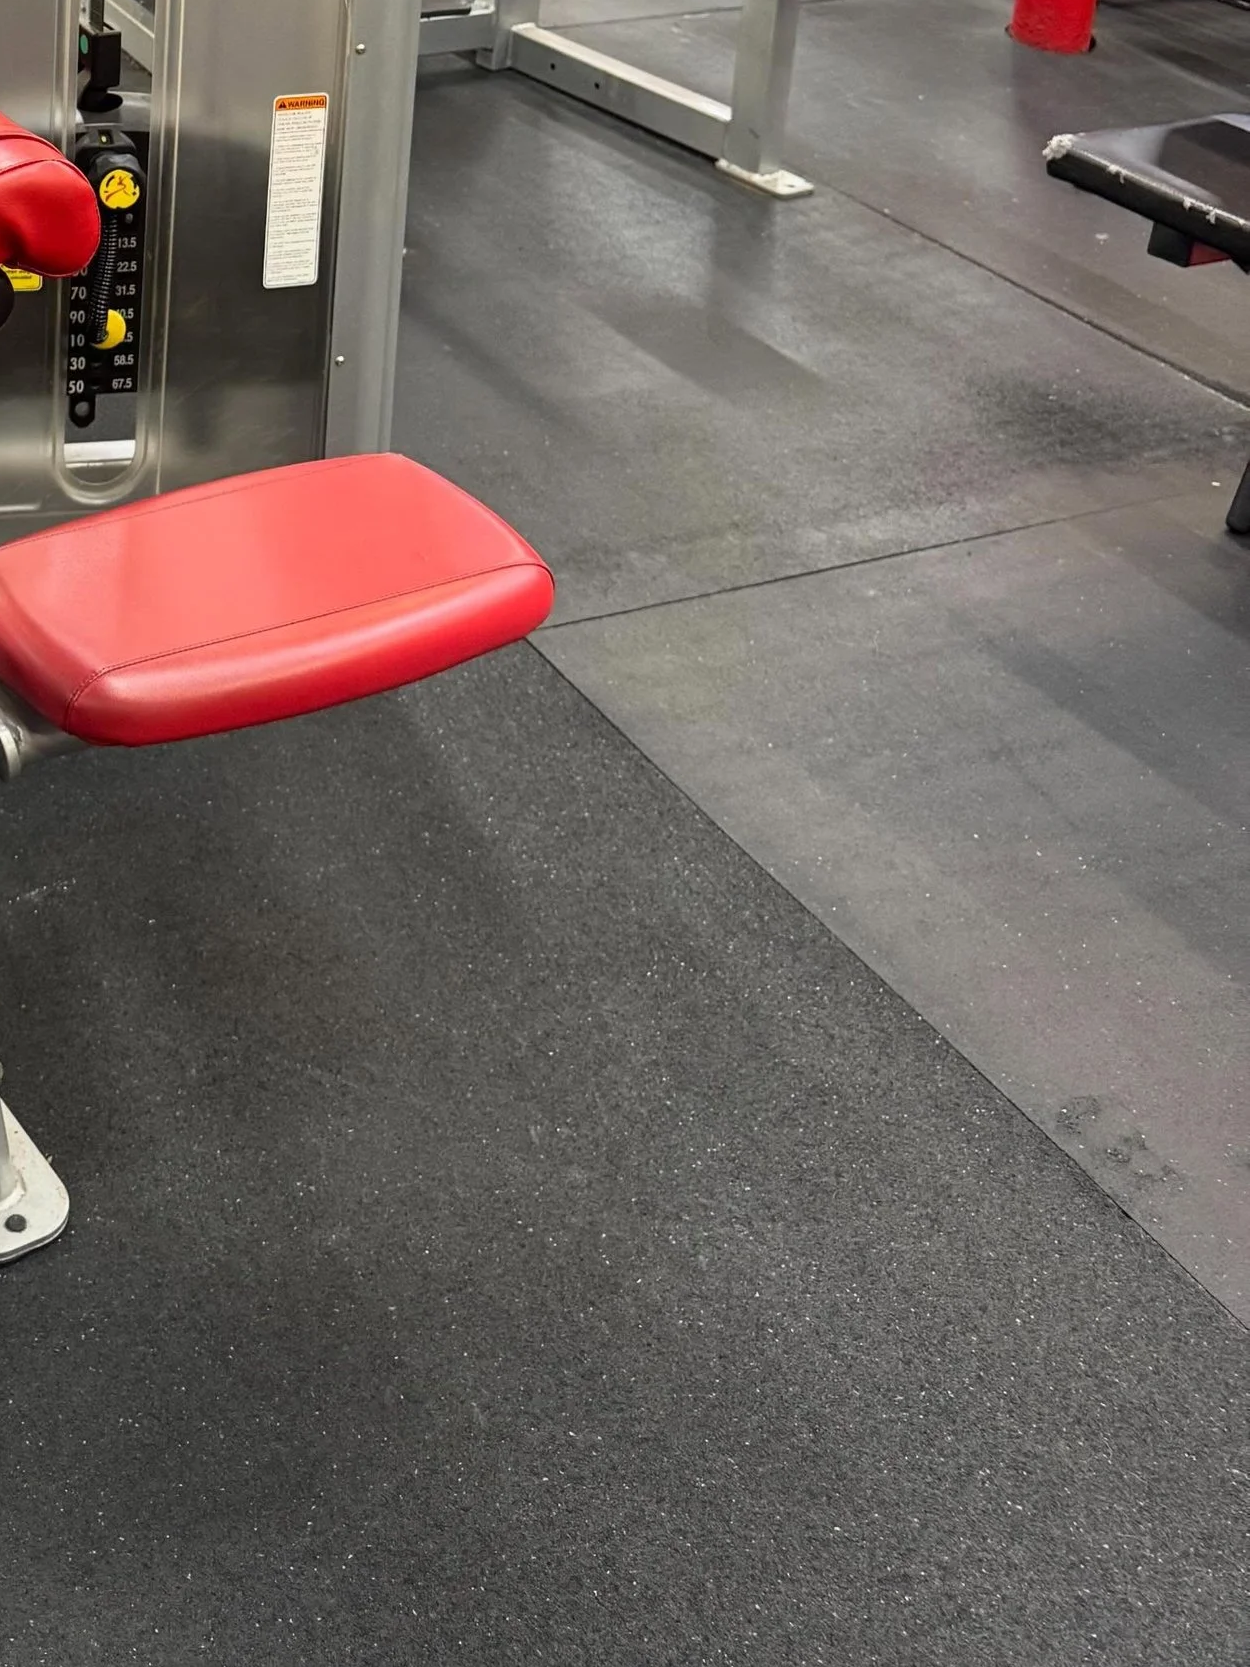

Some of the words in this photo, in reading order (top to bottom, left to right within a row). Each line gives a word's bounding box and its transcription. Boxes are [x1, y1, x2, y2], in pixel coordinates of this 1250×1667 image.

[287, 98, 325, 108] WARNING
[117, 237, 137, 249] 13.5
[116, 261, 137, 273] 22.5
[70, 286, 87, 301] 70
[115, 284, 136, 297] 31.5
[69, 310, 86, 324] 90
[114, 354, 134, 366] 58.5
[112, 378, 132, 390] 67.5
